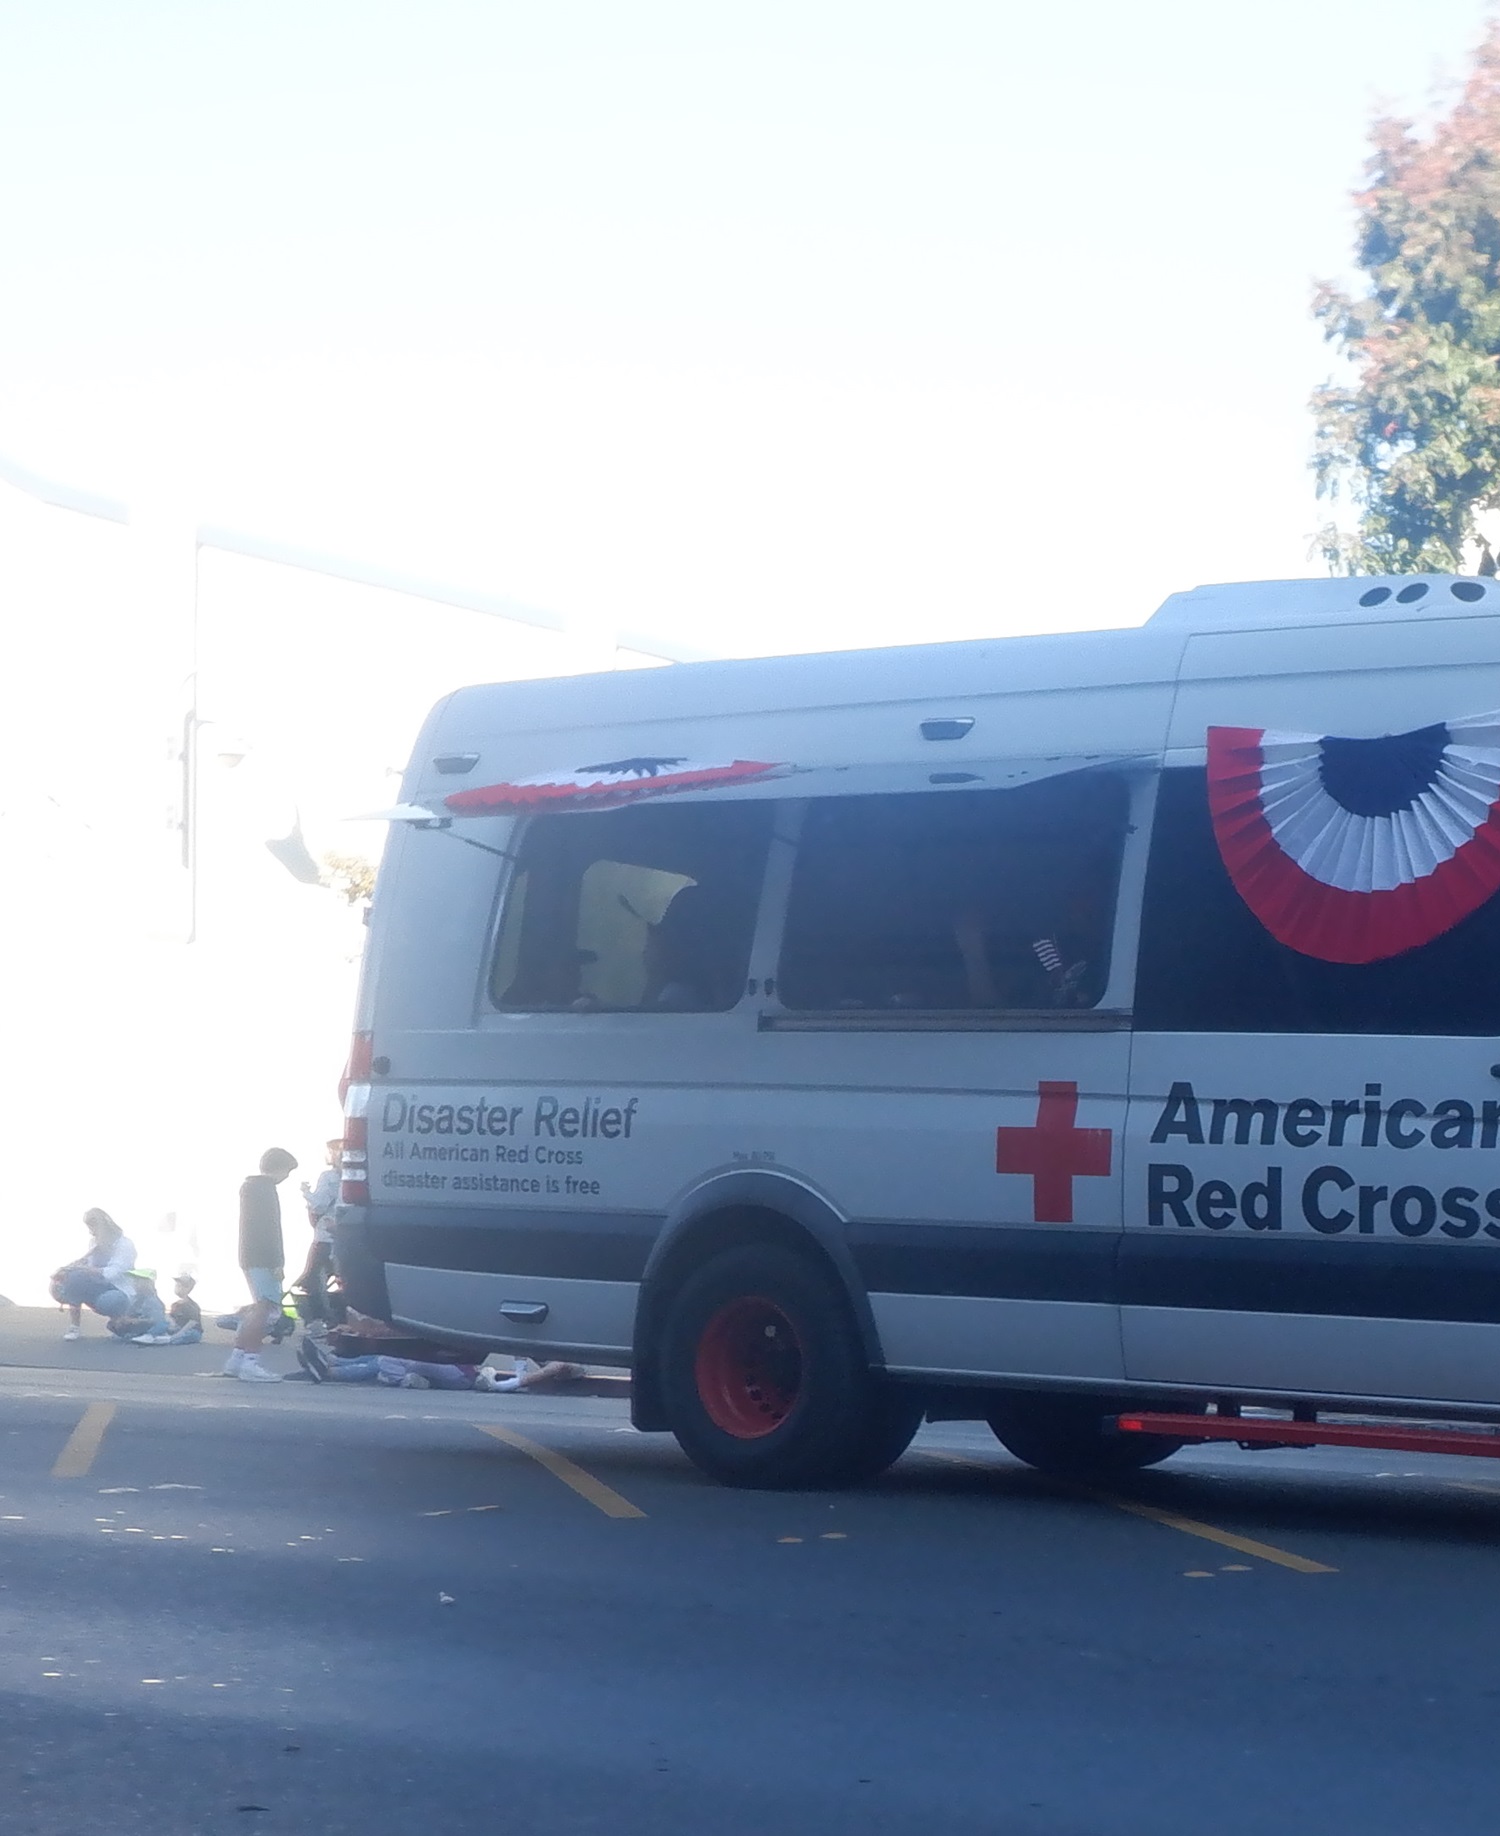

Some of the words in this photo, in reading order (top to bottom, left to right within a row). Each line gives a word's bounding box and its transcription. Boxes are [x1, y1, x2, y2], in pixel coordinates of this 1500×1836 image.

[382, 1093, 523, 1136] Disaster
[534, 1096, 639, 1138] Relief
[382, 1142, 404, 1159] All
[409, 1142, 489, 1161] American
[495, 1144, 529, 1163] Red
[535, 1146, 583, 1165] Cross
[382, 1169, 448, 1189] disaster
[452, 1174, 540, 1193] assistance
[546, 1175, 559, 1193] is
[565, 1176, 601, 1194] free
[1147, 1163, 1283, 1230] Red
